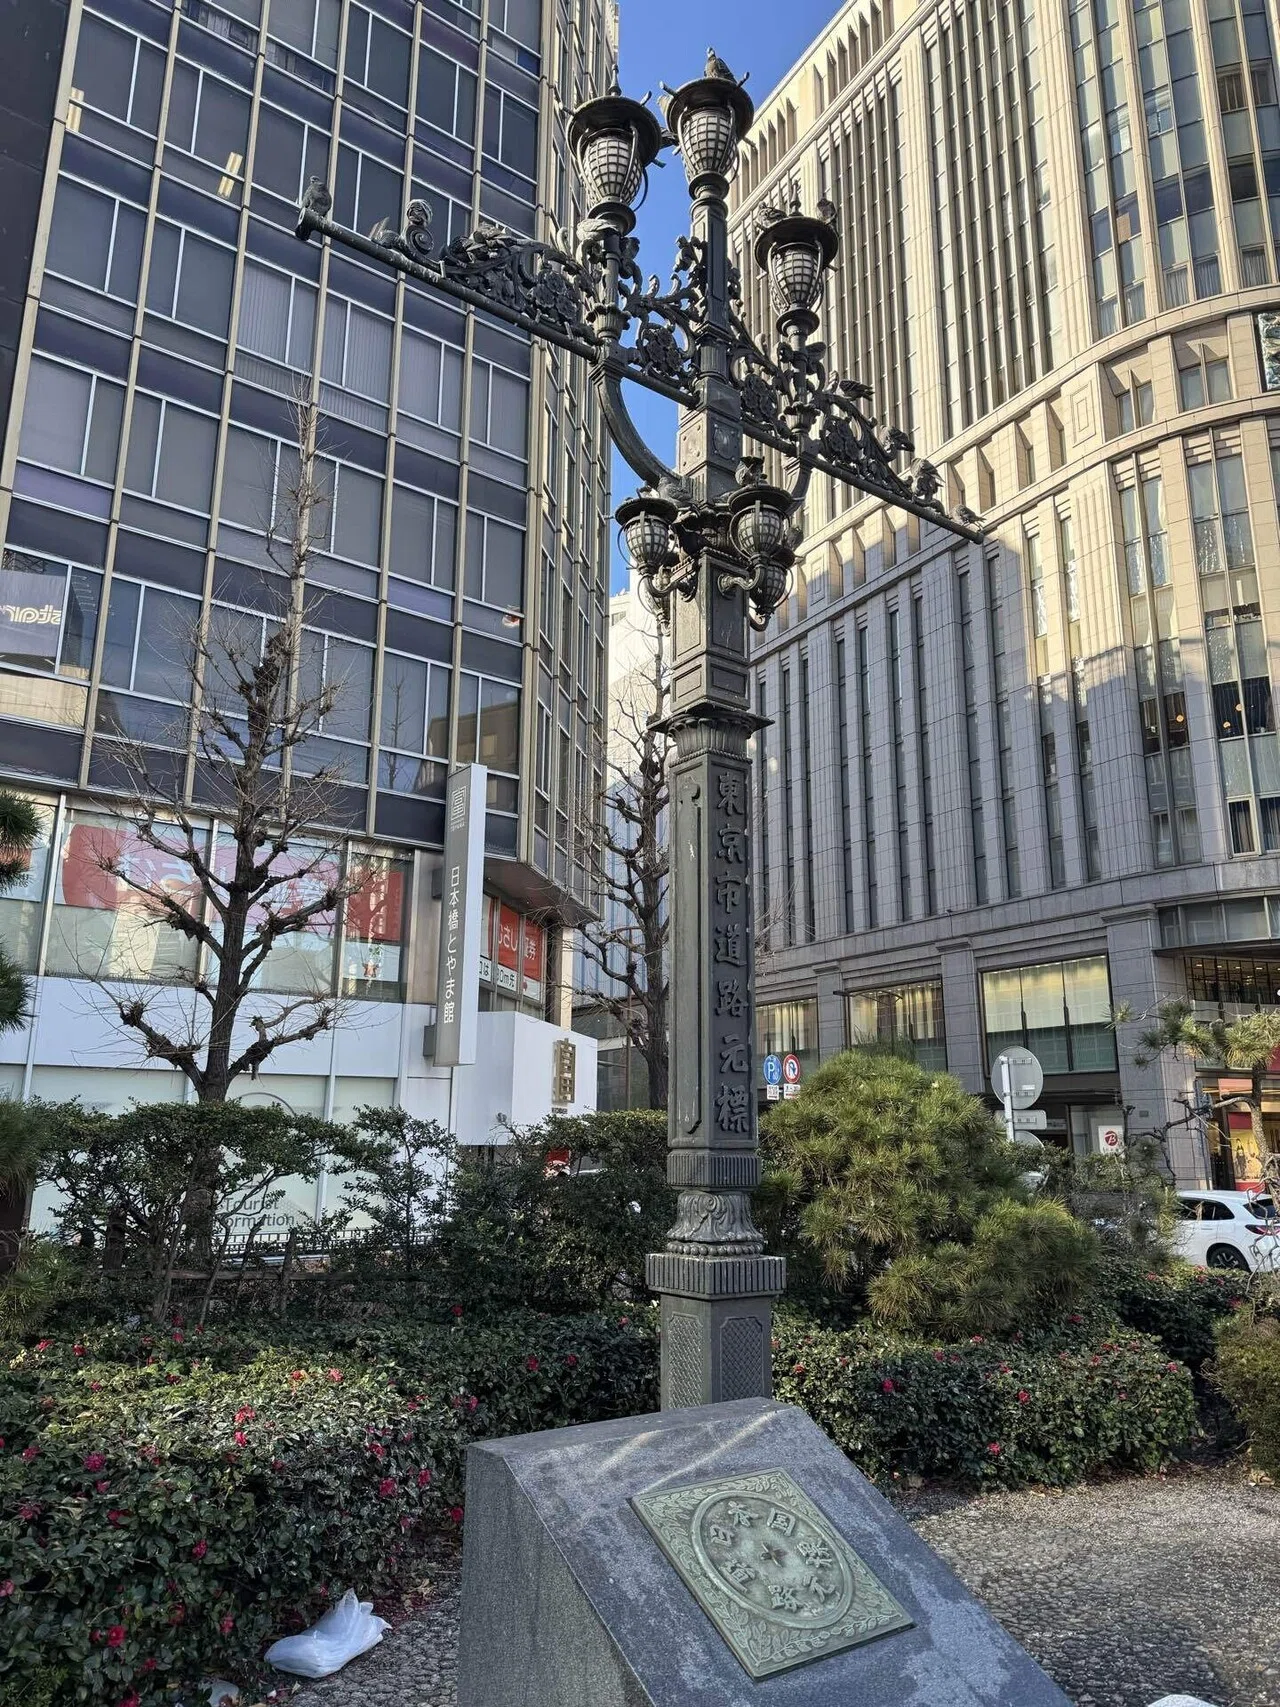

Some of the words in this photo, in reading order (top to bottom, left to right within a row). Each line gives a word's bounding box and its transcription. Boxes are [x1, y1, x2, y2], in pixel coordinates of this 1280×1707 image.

[444, 866, 460, 1024] 日本橋とやま館
[716, 772, 749, 1132] 東京市道路元標
[224, 1197, 279, 1210] Tourst
